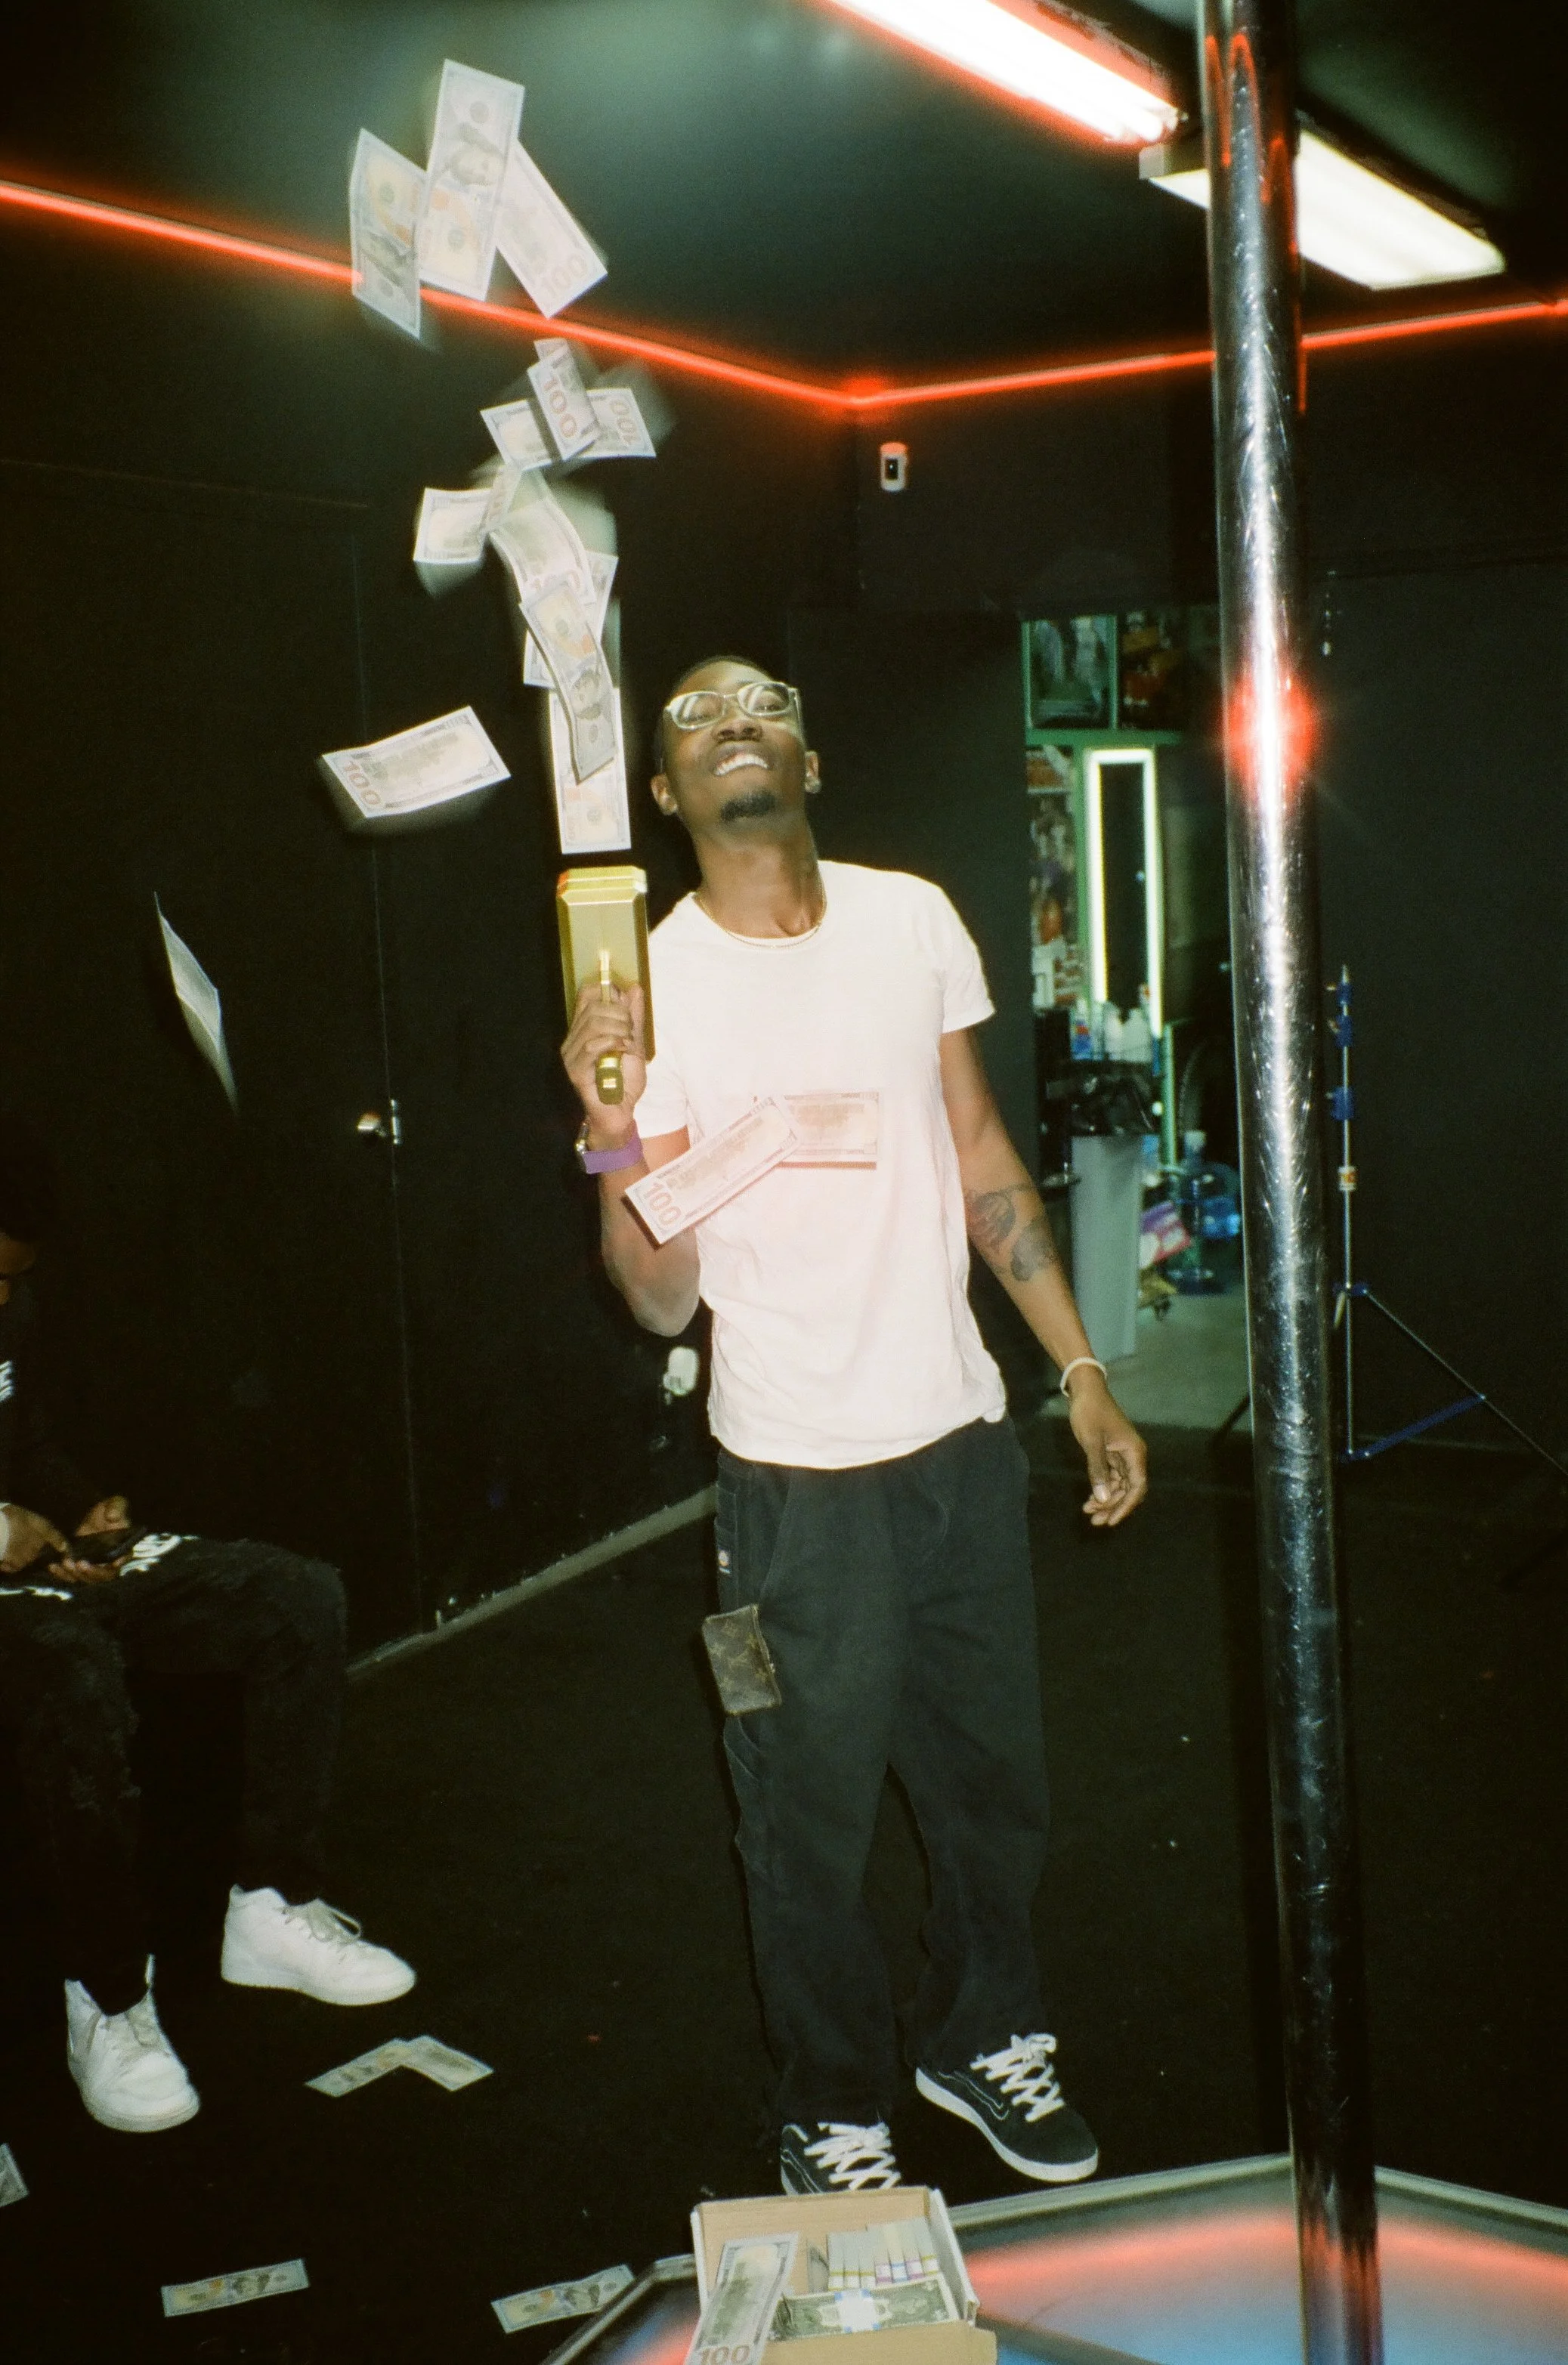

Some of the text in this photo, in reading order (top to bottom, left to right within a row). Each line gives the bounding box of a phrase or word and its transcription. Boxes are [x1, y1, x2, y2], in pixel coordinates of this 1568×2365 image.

[543, 378, 577, 438] 100
[608, 399, 638, 444] 100
[343, 761, 381, 805] 100
[642, 1182, 682, 1226] 100
[700, 2345, 750, 2365] 100
